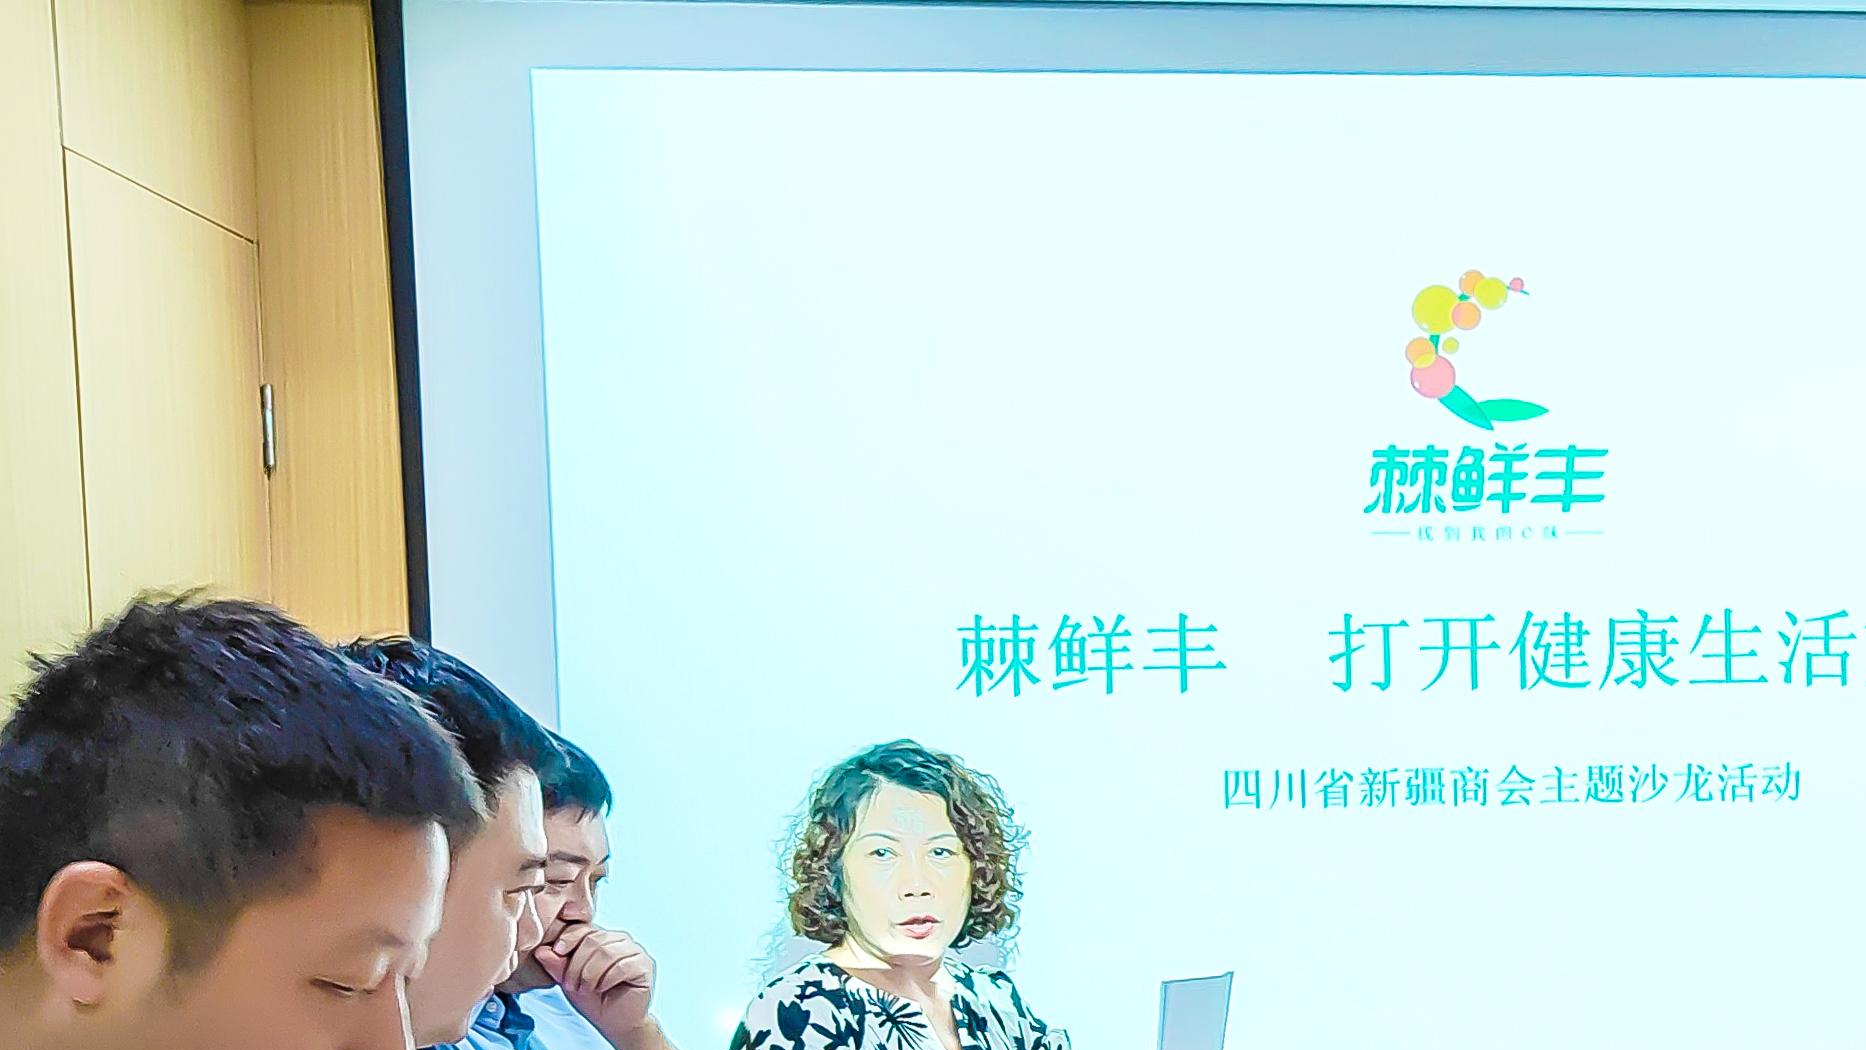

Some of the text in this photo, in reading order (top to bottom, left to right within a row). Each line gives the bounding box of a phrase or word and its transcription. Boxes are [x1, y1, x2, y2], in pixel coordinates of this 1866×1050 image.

[1363, 441, 1609, 514] 棘鲜丰
[955, 612, 1228, 698] 棘鲜丰
[1223, 761, 1801, 810] 四川省新疆商会主题沙龙活动
